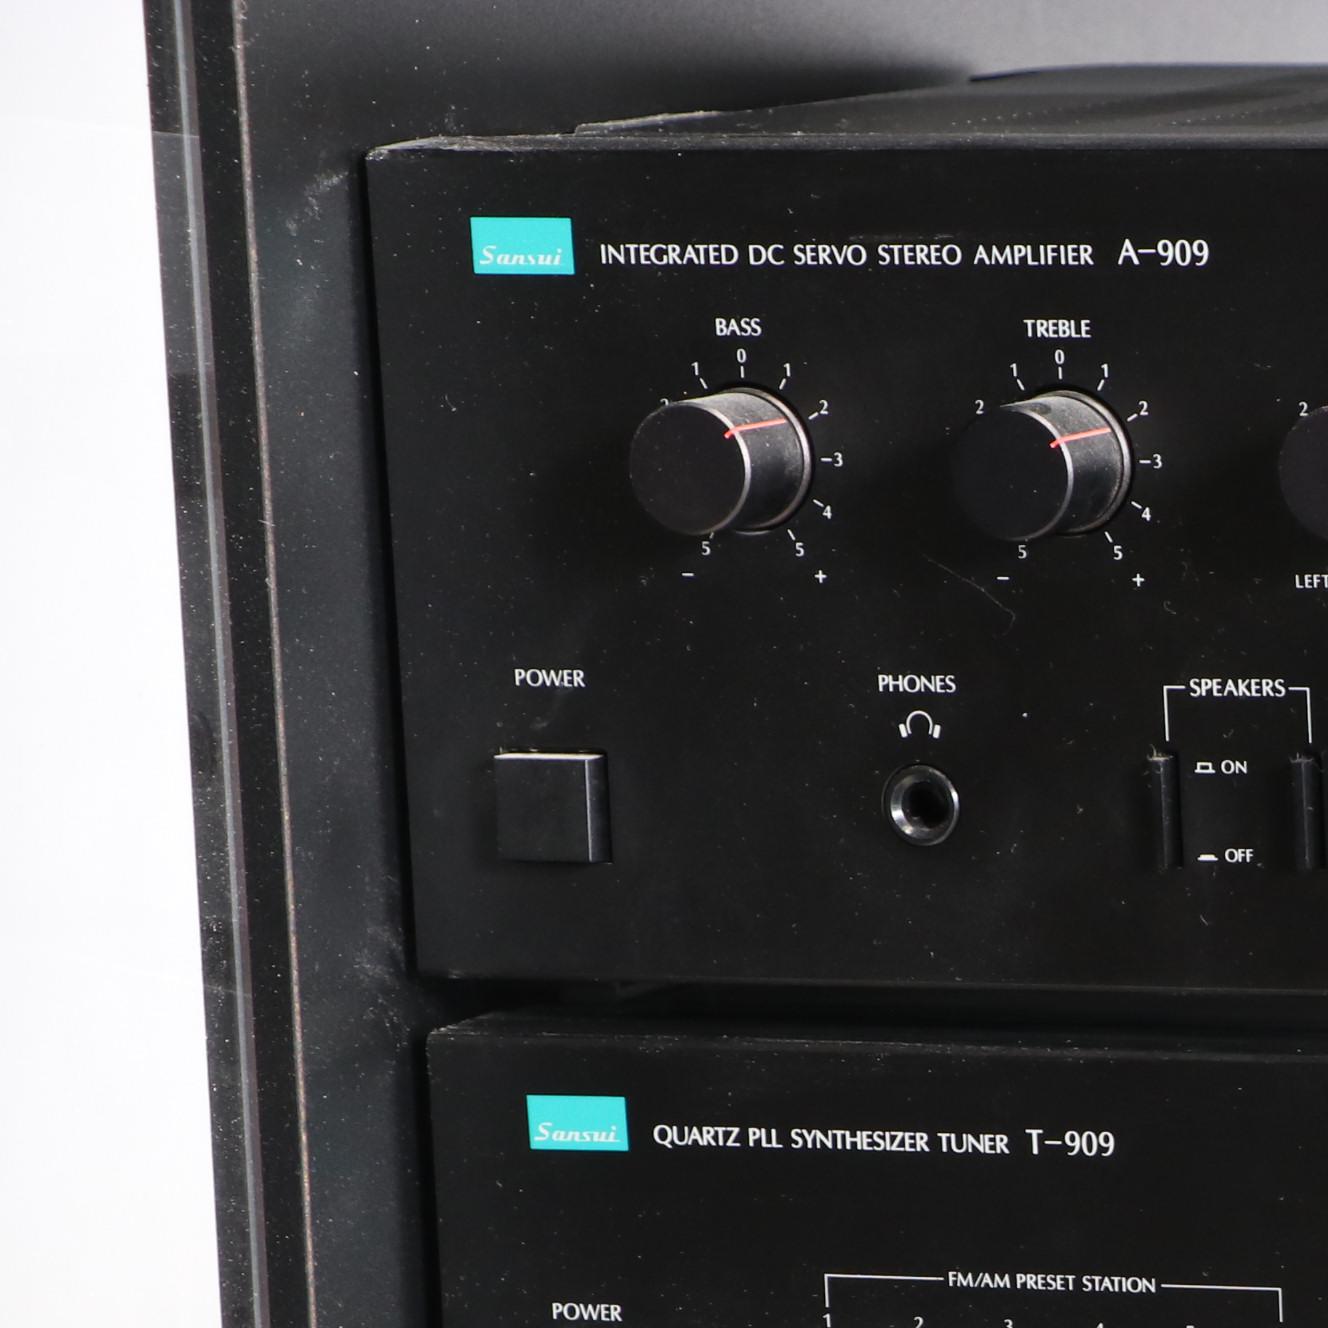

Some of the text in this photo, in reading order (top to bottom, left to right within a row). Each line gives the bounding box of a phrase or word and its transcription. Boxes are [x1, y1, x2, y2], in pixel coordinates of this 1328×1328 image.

[480, 245, 564, 266] Sansui
[600, 238, 1209, 267] INTEGRATED DC SERVO STEREO AMPLIFIER A-909
[715, 317, 762, 337] BASS
[1023, 319, 1092, 338] TREBLE
[514, 668, 586, 688] POWER
[877, 674, 957, 693] PHONES
[1189, 678, 1286, 698] SPEAKERS
[1220, 759, 1248, 775] ON
[1224, 848, 1254, 863] OFF
[534, 1121, 621, 1144] Sansui
[653, 1124, 1115, 1157] QUARTZ PLL SYNTHESIZER TUNER T-909
[948, 1271, 1156, 1293] FM/AM PRESET STATION
[551, 1302, 623, 1322] POWER
[822, 1313, 832, 1328] 1
